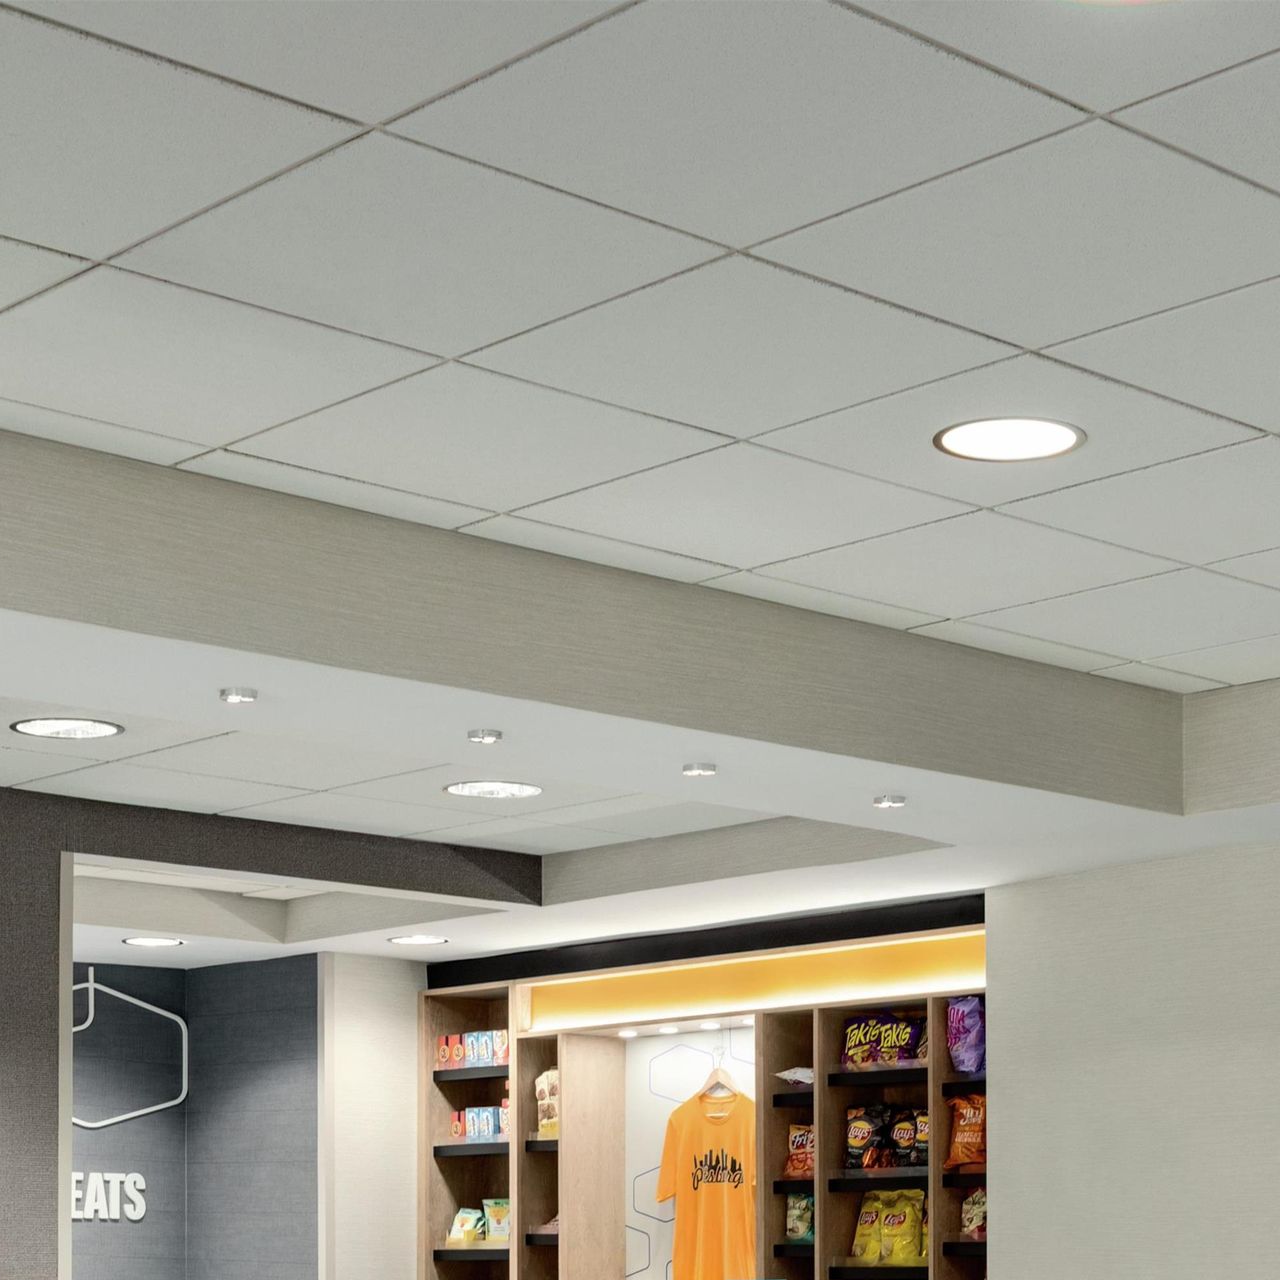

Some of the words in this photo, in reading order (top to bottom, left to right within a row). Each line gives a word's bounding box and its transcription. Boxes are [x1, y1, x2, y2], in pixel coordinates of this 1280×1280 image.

[845, 1019, 881, 1053] Takis
[878, 1022, 912, 1050] Takis
[72, 1171, 147, 1221] EATS
